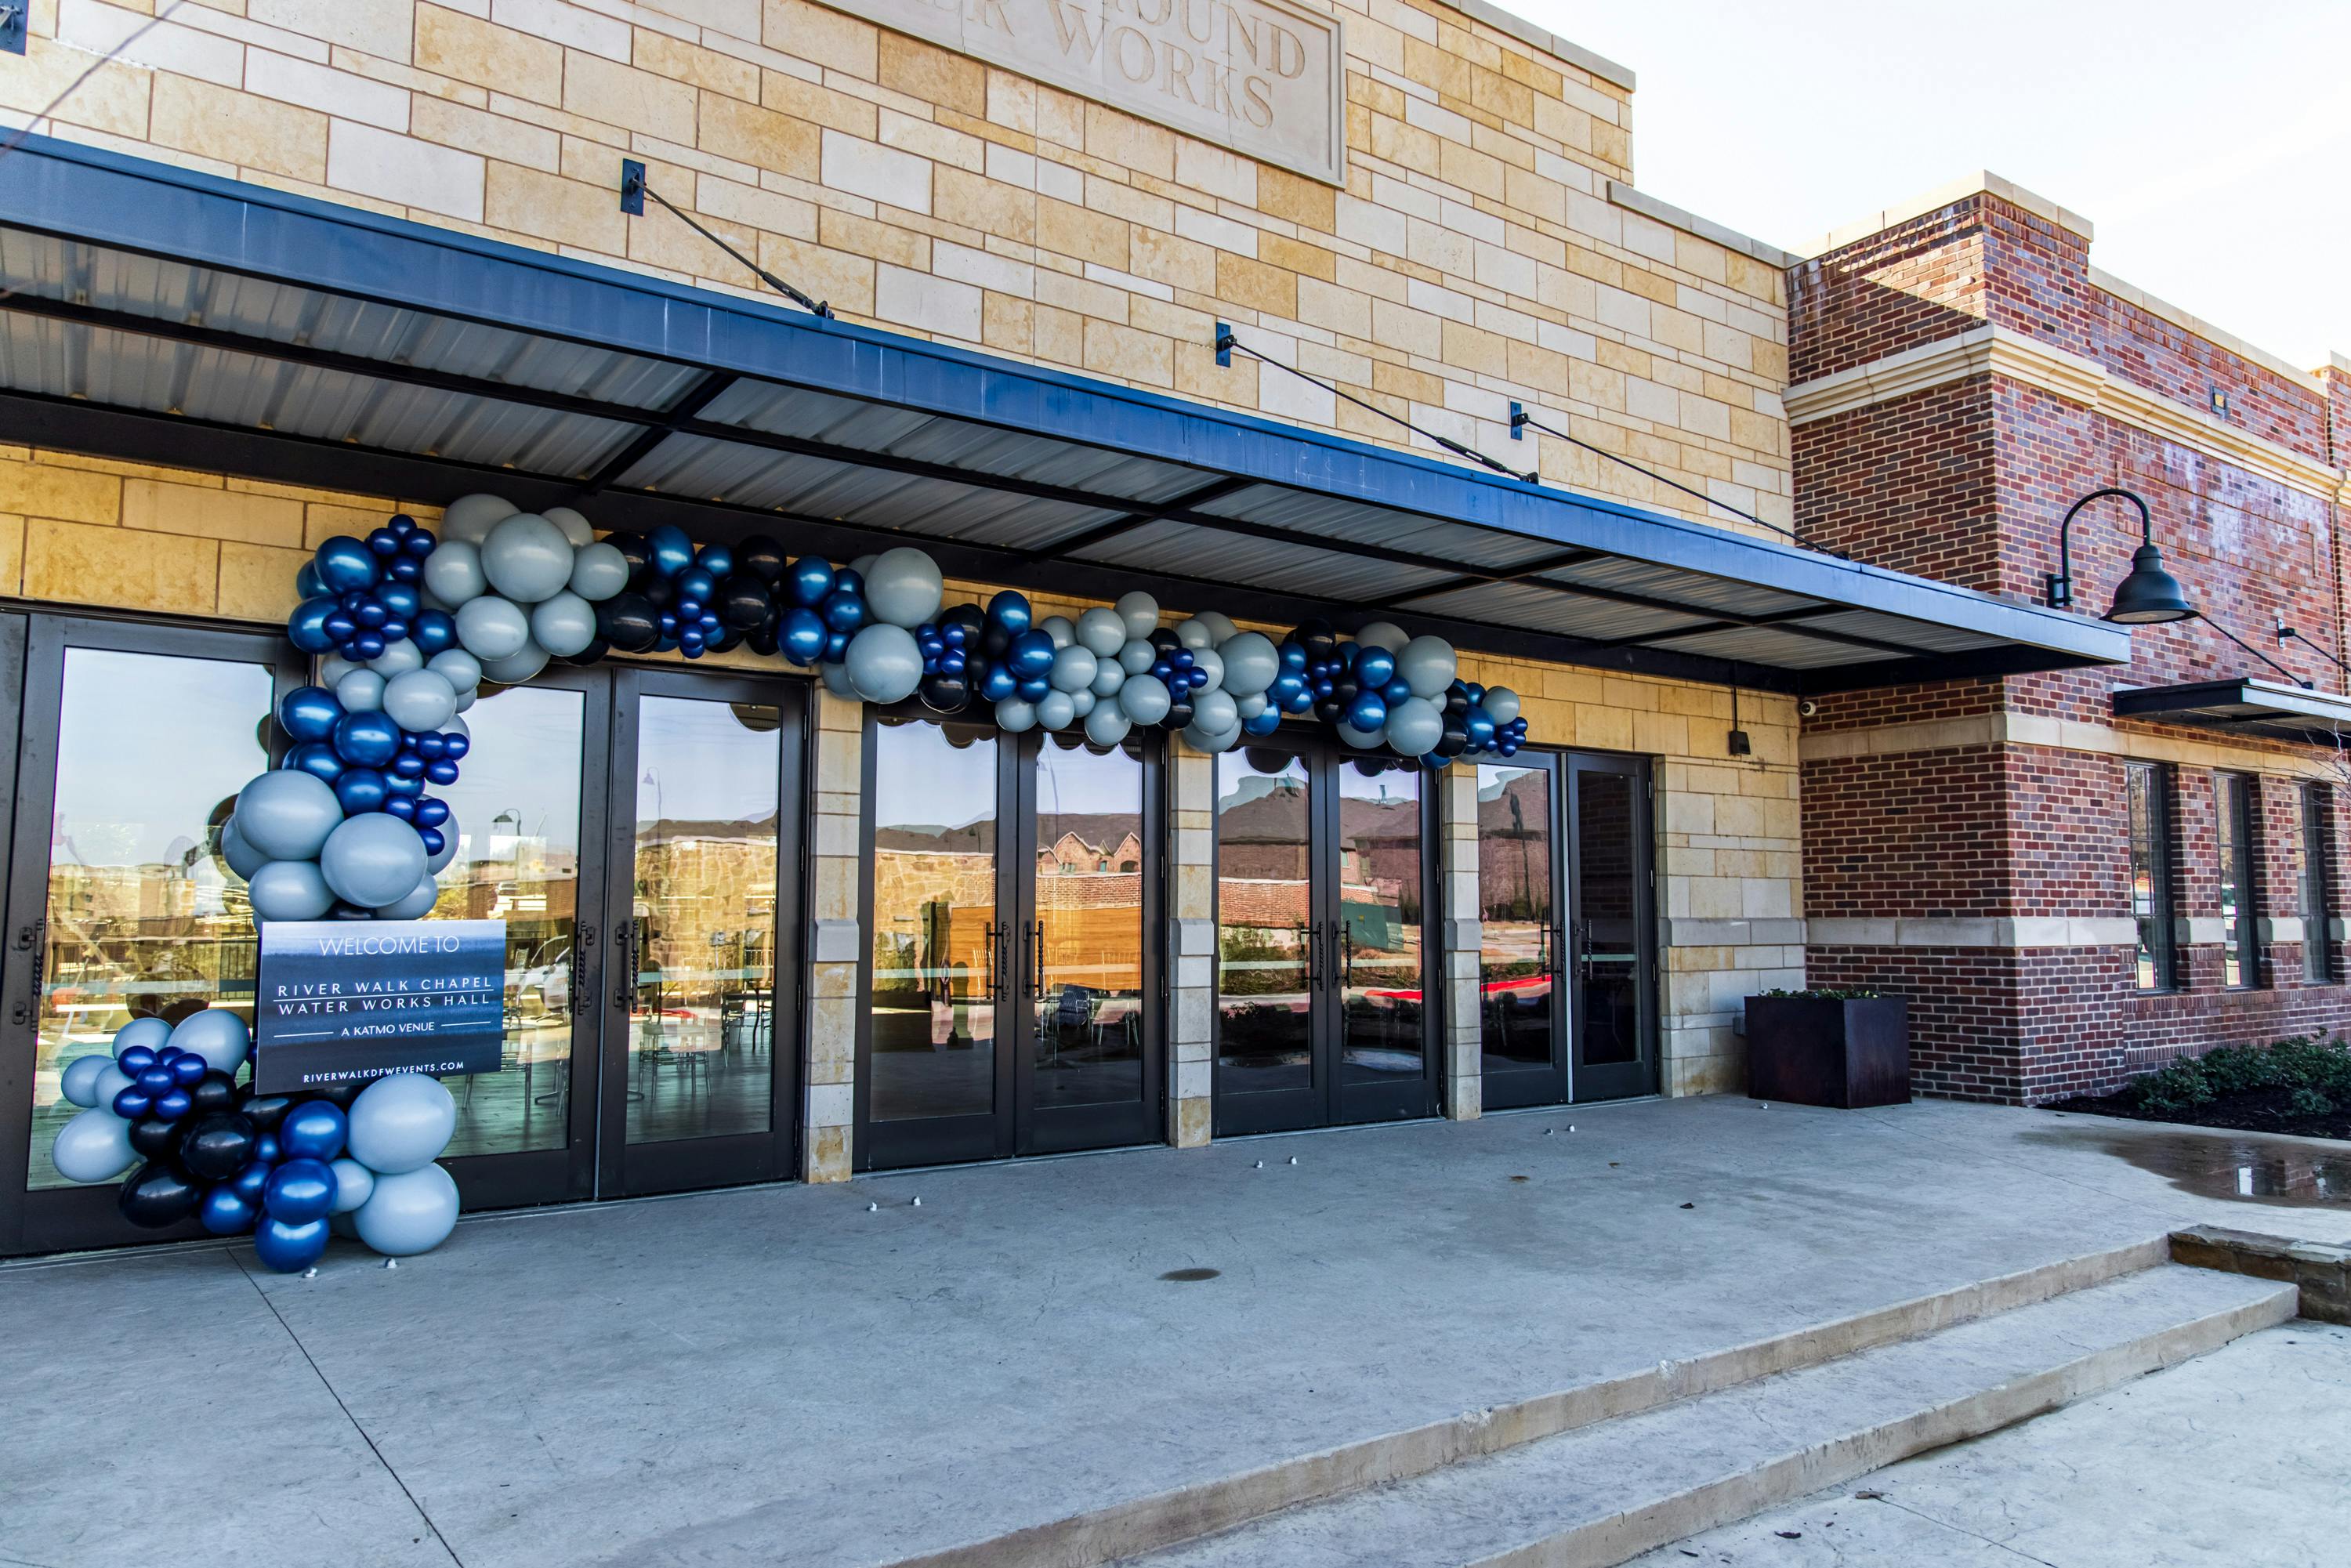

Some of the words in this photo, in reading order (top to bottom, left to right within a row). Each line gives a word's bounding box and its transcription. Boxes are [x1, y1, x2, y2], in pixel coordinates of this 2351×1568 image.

[1047, 0, 1274, 129] WORKS
[319, 936, 428, 956] WELCOME
[434, 935, 460, 953] TO
[277, 983, 342, 998] RIVER
[355, 980, 409, 994] WALK
[420, 976, 492, 990] CHAPEL
[277, 1001, 350, 1016] WATER
[362, 997, 432, 1011] WORKS
[444, 994, 490, 1006] HALL
[340, 1028, 350, 1037] A
[353, 1024, 396, 1036] KATMO
[398, 1022, 435, 1033] VENUE
[302, 1061, 465, 1083] RIVERWALKDFWEVENTS.COM
